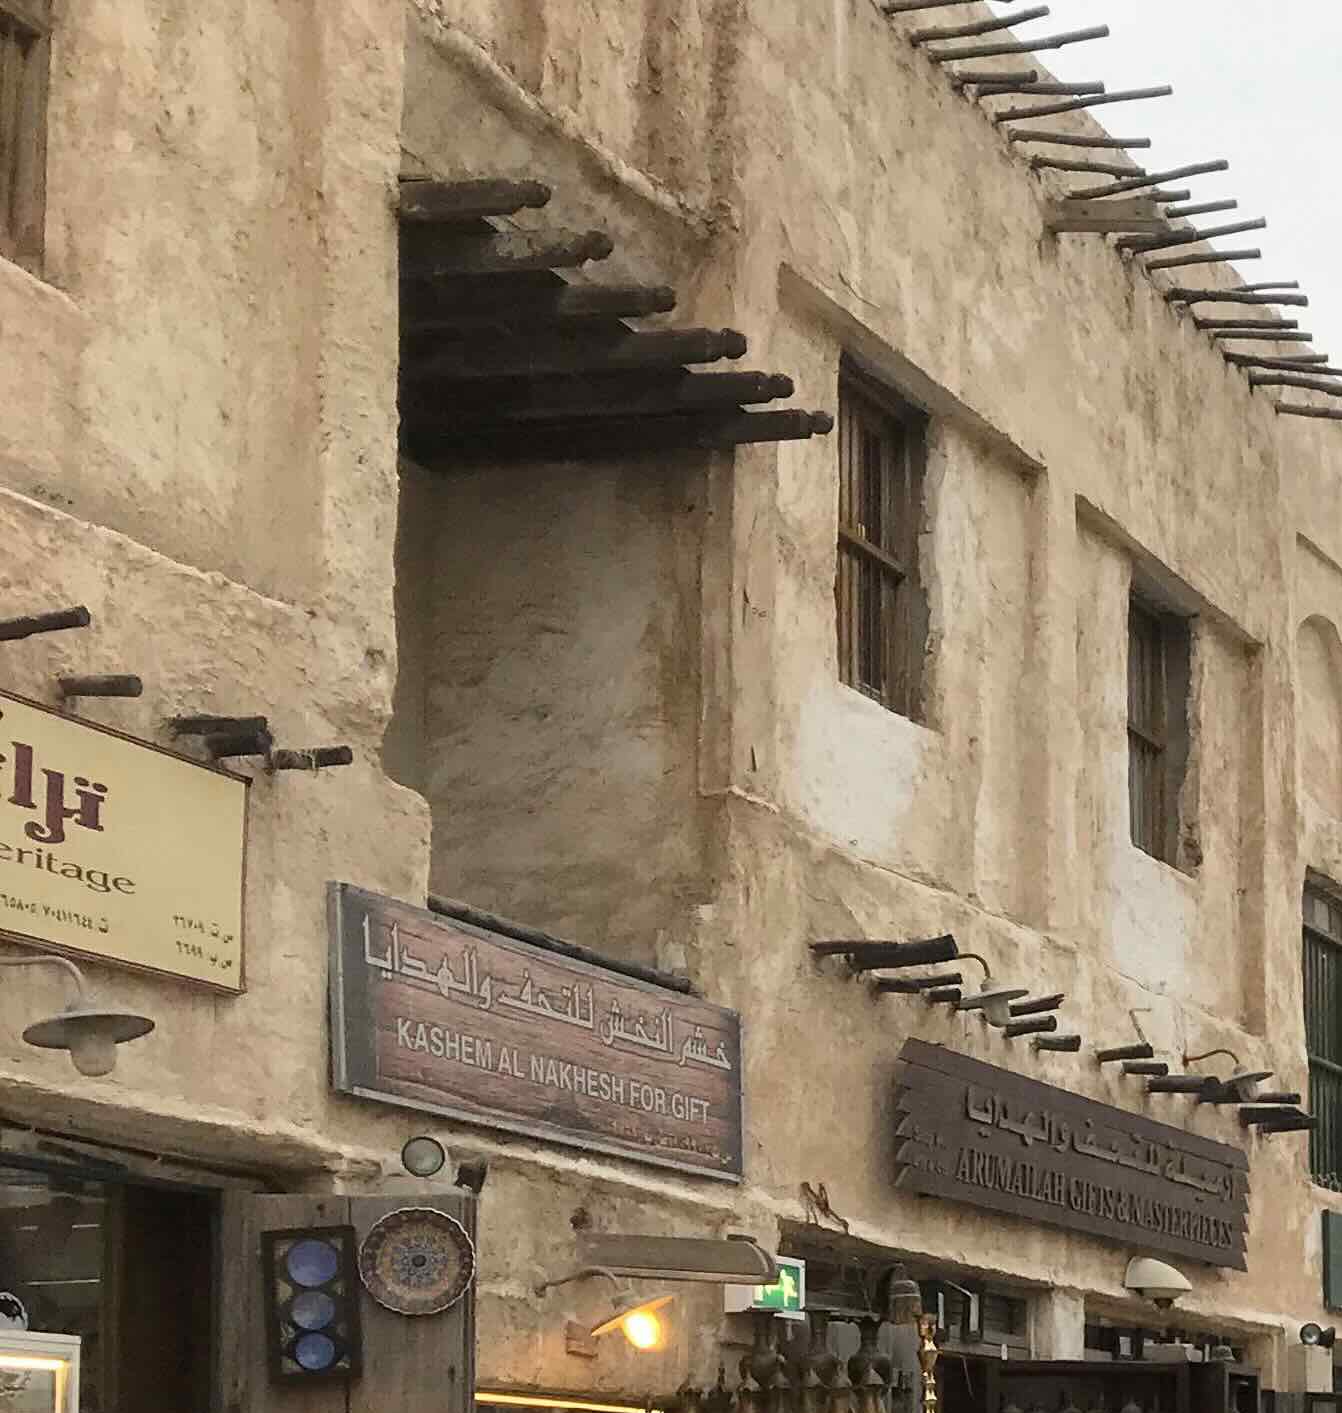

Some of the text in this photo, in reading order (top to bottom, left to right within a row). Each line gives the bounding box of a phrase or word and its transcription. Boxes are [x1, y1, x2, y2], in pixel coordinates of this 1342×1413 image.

[0, 708, 109, 844] ترا
[363, 913, 732, 1071] خشم النخش للتحف والهدايا
[396, 1016, 711, 1124] KASHEM AL NAKHESH FOR GIFT
[1069, 1175, 1115, 1219] GIFTS
